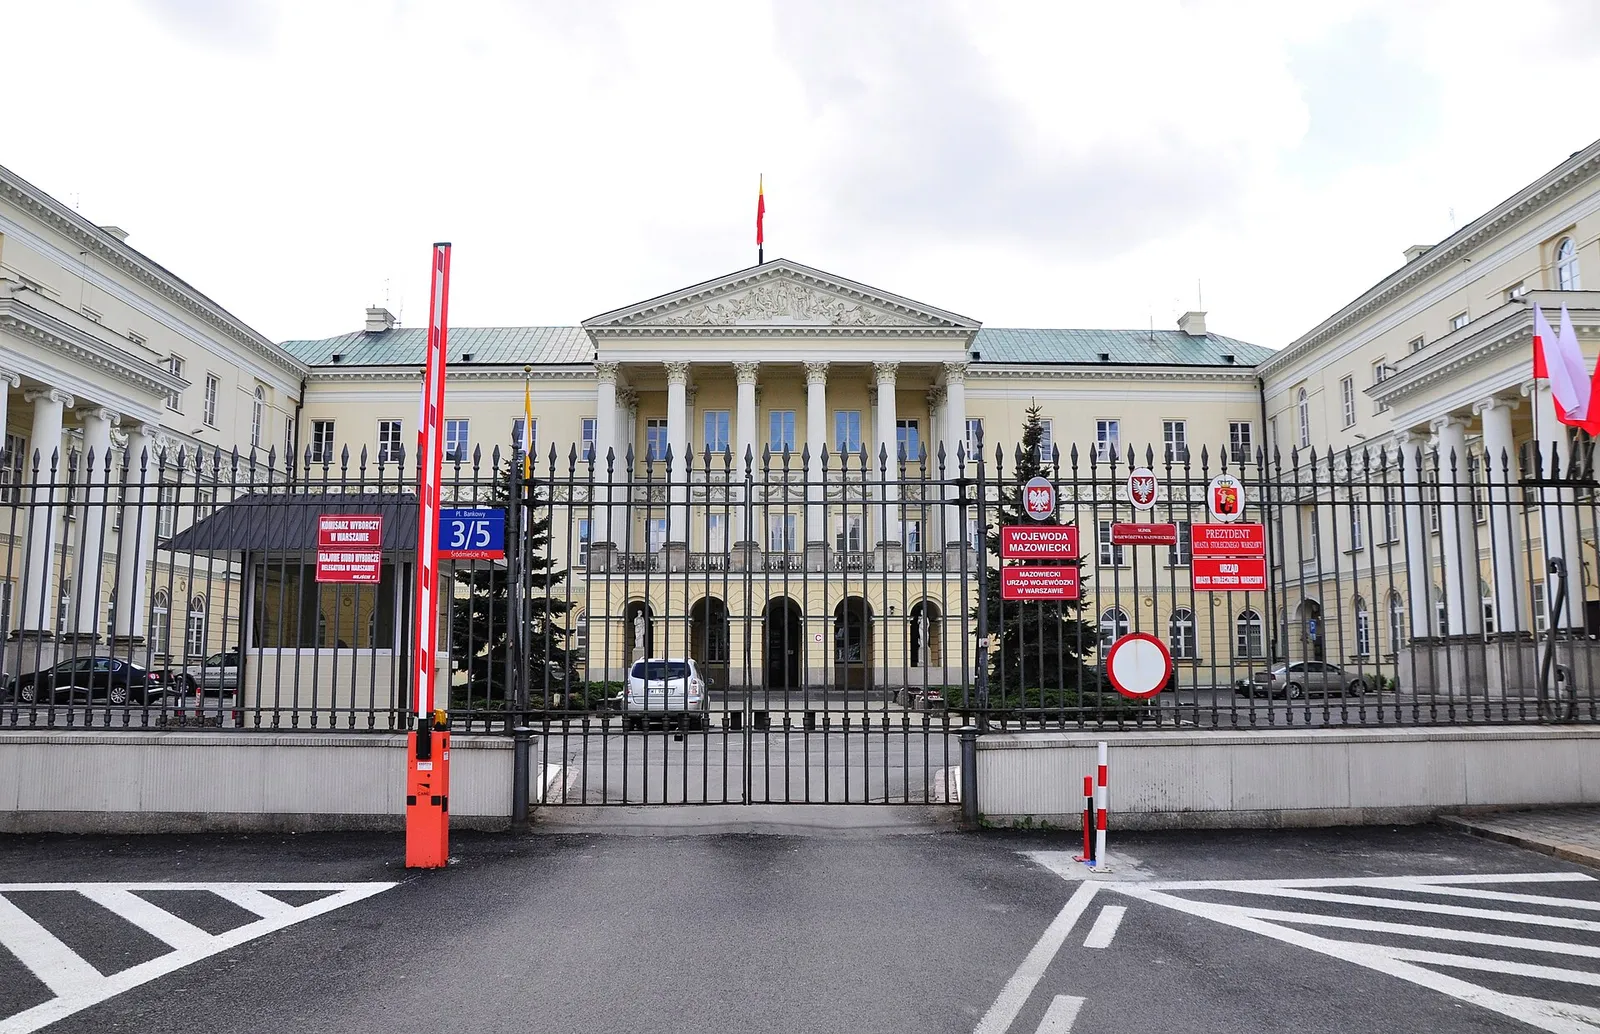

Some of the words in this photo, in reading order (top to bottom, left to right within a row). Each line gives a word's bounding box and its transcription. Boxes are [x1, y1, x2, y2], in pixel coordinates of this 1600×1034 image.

[463, 510, 486, 518] Bankowy
[321, 520, 349, 530] KOMISARZ
[350, 520, 380, 530] WYBORCZY
[330, 532, 336, 541] W
[337, 532, 370, 541] WARSZAWIE
[450, 520, 491, 550] 3/5
[1011, 532, 1069, 541] WOJEWODA
[1205, 529, 1251, 539] PREZYDENT
[1009, 543, 1071, 552] MAZOWIECKI
[1193, 541, 1209, 549] MIASTA
[1210, 541, 1240, 549] STOŁECZNEGO
[1240, 541, 1263, 549] WARSZAWY
[319, 553, 341, 562] KRAJOWE
[341, 553, 355, 562] BIURO
[355, 553, 379, 562] WYBORCZE
[450, 550, 480, 558] Śródmieście
[351, 564, 375, 572] WARSZAWIE
[1219, 563, 1239, 575] URZĄD
[1006, 579, 1029, 587] URZĄD
[1029, 578, 1074, 586] WOJEWÓDZKI
[1195, 576, 1211, 585] MIASTA
[1211, 576, 1240, 585] STOŁECZNEGO
[1240, 576, 1263, 585] WARSZAWY
[815, 634, 822, 642] C
